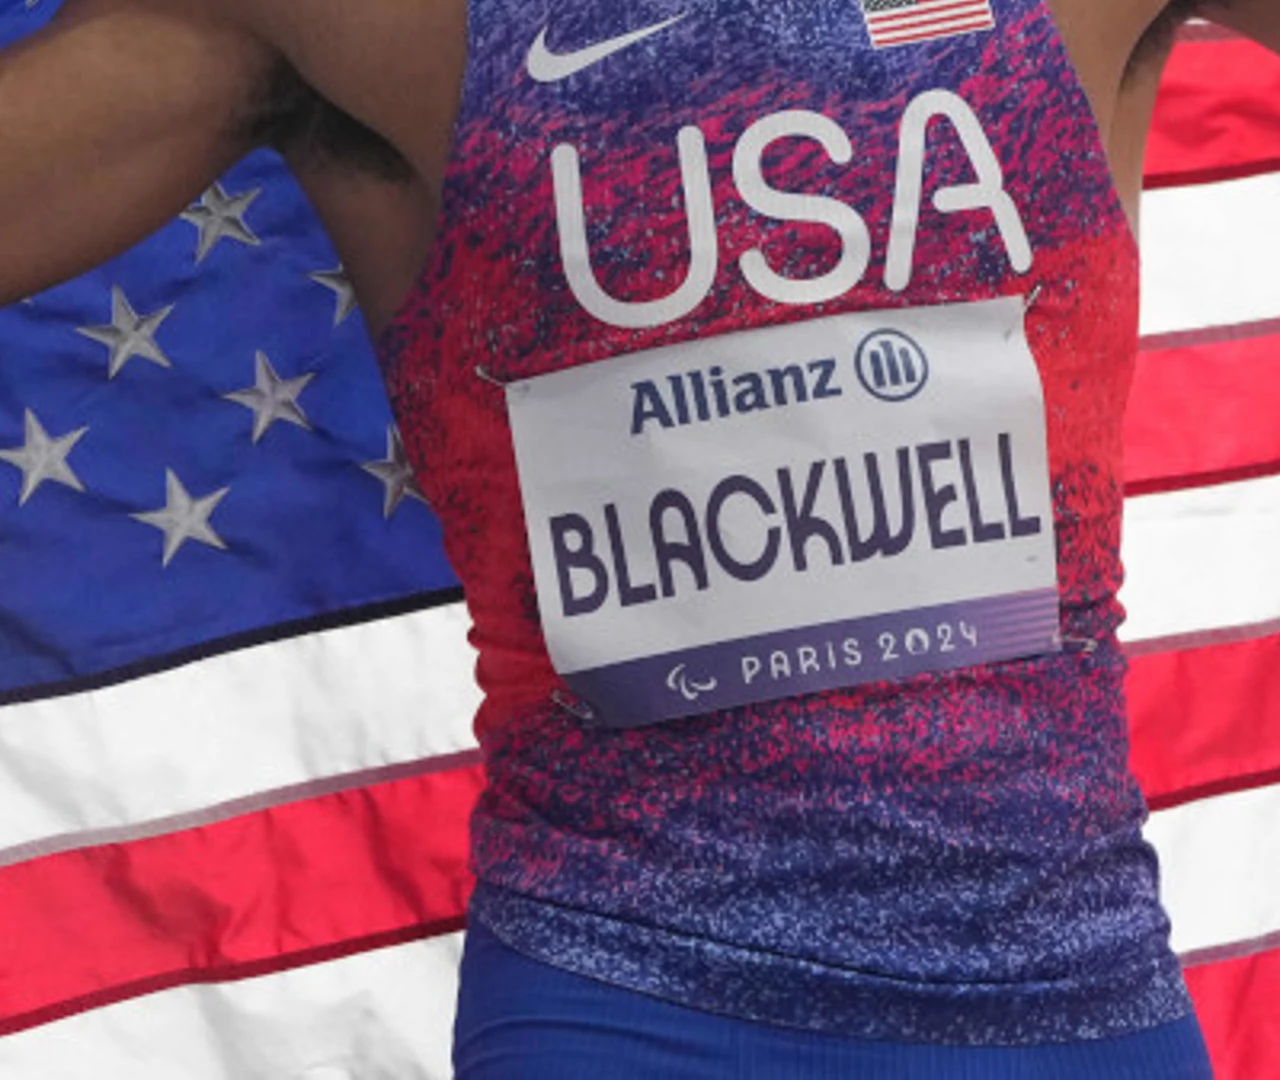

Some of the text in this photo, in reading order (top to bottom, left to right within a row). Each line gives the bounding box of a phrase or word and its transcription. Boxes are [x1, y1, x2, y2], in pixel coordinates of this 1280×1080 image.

[549, 88, 1032, 329] USA
[629, 357, 842, 435] Allianz
[549, 433, 1041, 617] BLACKWELL
[741, 621, 978, 685] PARIS 2024
